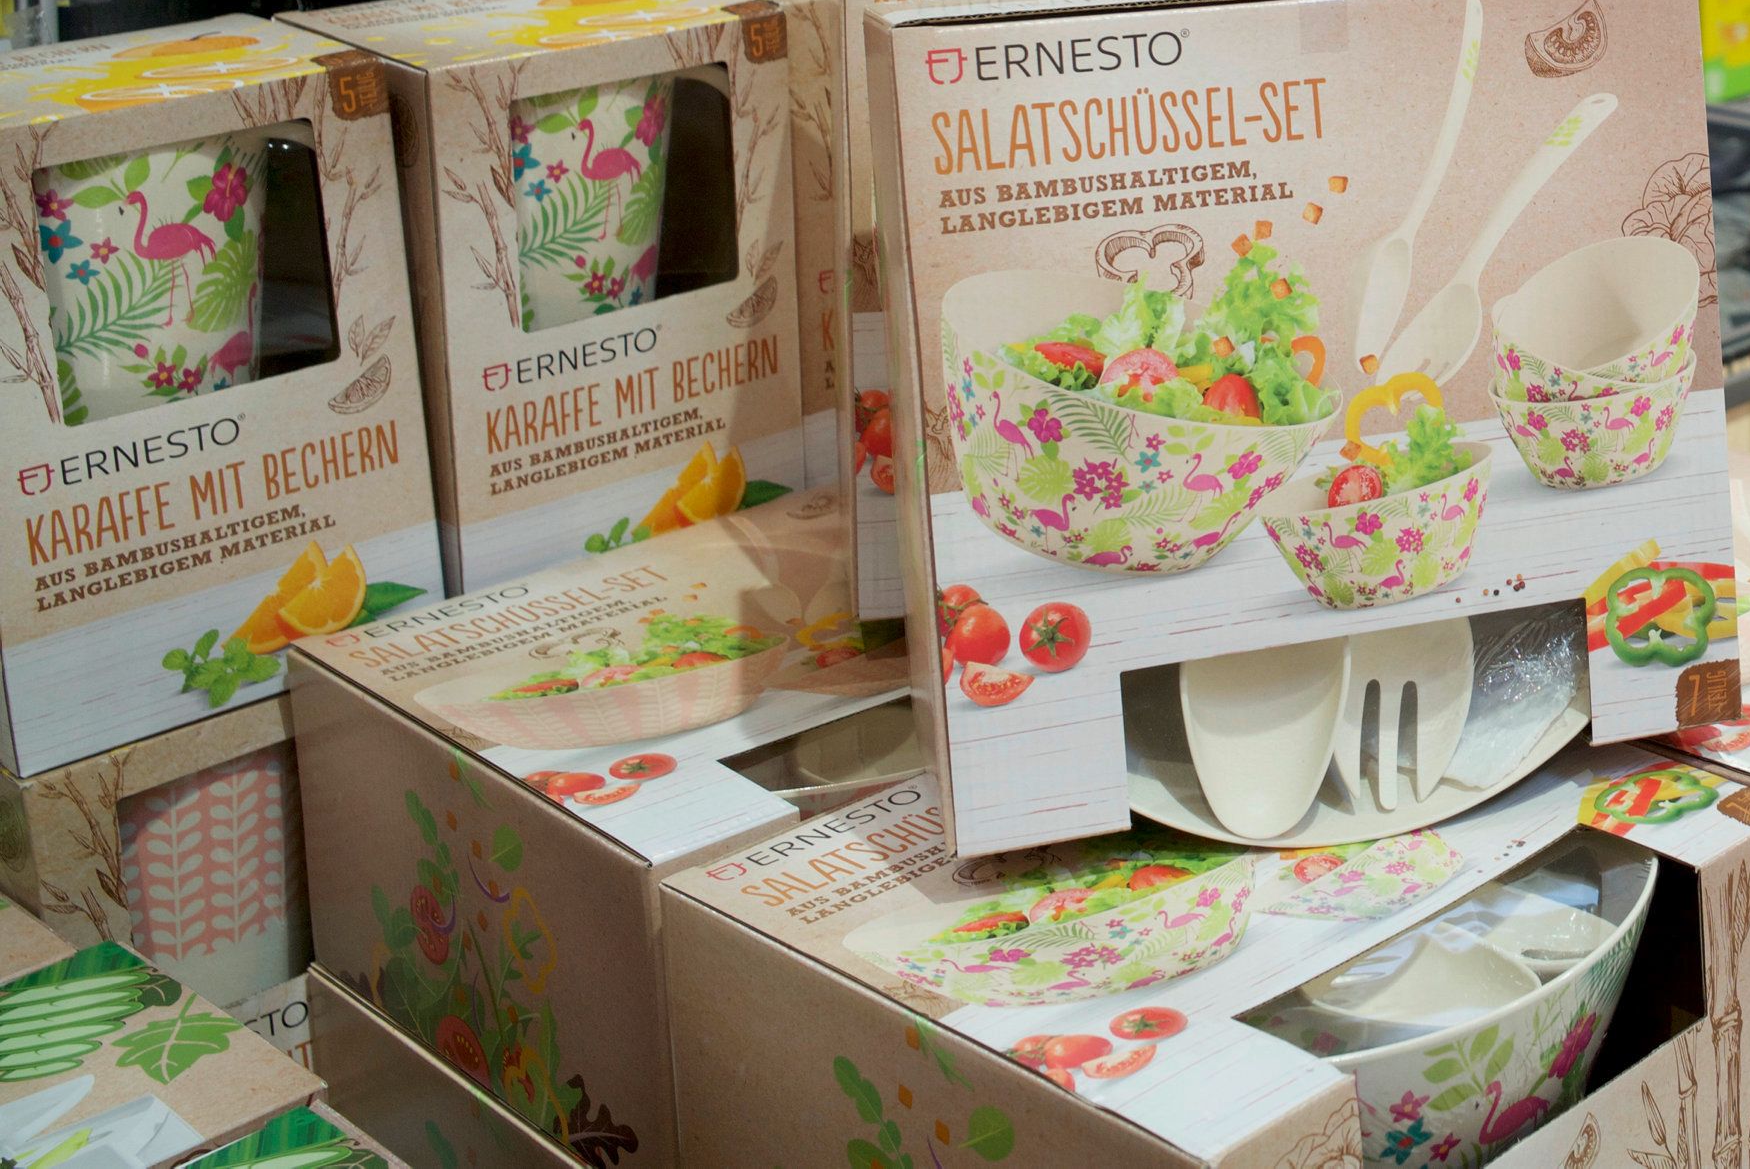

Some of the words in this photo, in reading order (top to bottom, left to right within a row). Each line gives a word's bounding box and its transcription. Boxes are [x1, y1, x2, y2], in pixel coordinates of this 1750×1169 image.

[975, 31, 1184, 82] ERNESTO
[931, 77, 1327, 176] SALATSCHÜSSEL-SET
[938, 186, 987, 210] AUS
[997, 160, 1258, 203] BAMBUSHALTIGEM,
[940, 194, 1144, 235] LANGLEBIGEM
[1153, 182, 1294, 212] MATERIAL
[486, 383, 603, 455] KARAFFE
[615, 366, 660, 420] MIT
[672, 335, 779, 404] BECHERN
[516, 327, 658, 385] ERNESTO
[60, 418, 240, 486] ERNESTO
[489, 457, 523, 478] AUS
[529, 407, 703, 468] BAMBUSHALTIGEM,
[489, 444, 629, 496] LANGLEBIGEM
[635, 417, 727, 457] MATERIAL
[25, 481, 176, 567] KARAFFE
[189, 460, 246, 521] MIT
[263, 420, 400, 502] BECHERN
[34, 567, 77, 593] AUS
[85, 504, 307, 578] BAMBUSHALTIGEM,
[36, 551, 213, 613] LANGLEBIGEM
[220, 514, 337, 561] MATERIAL
[348, 565, 670, 669] SALATSCHÜSSEL-SET
[362, 584, 530, 639] ERNESTO
[388, 631, 553, 682] LANGLEBIGEM
[559, 595, 669, 633] MATERIAL
[1688, 674, 1700, 717] 7
[740, 806, 945, 909] SALATSCHÜS
[745, 789, 922, 867] ERNESTO
[785, 896, 831, 918] AUS
[831, 841, 946, 897] BAMBUSH
